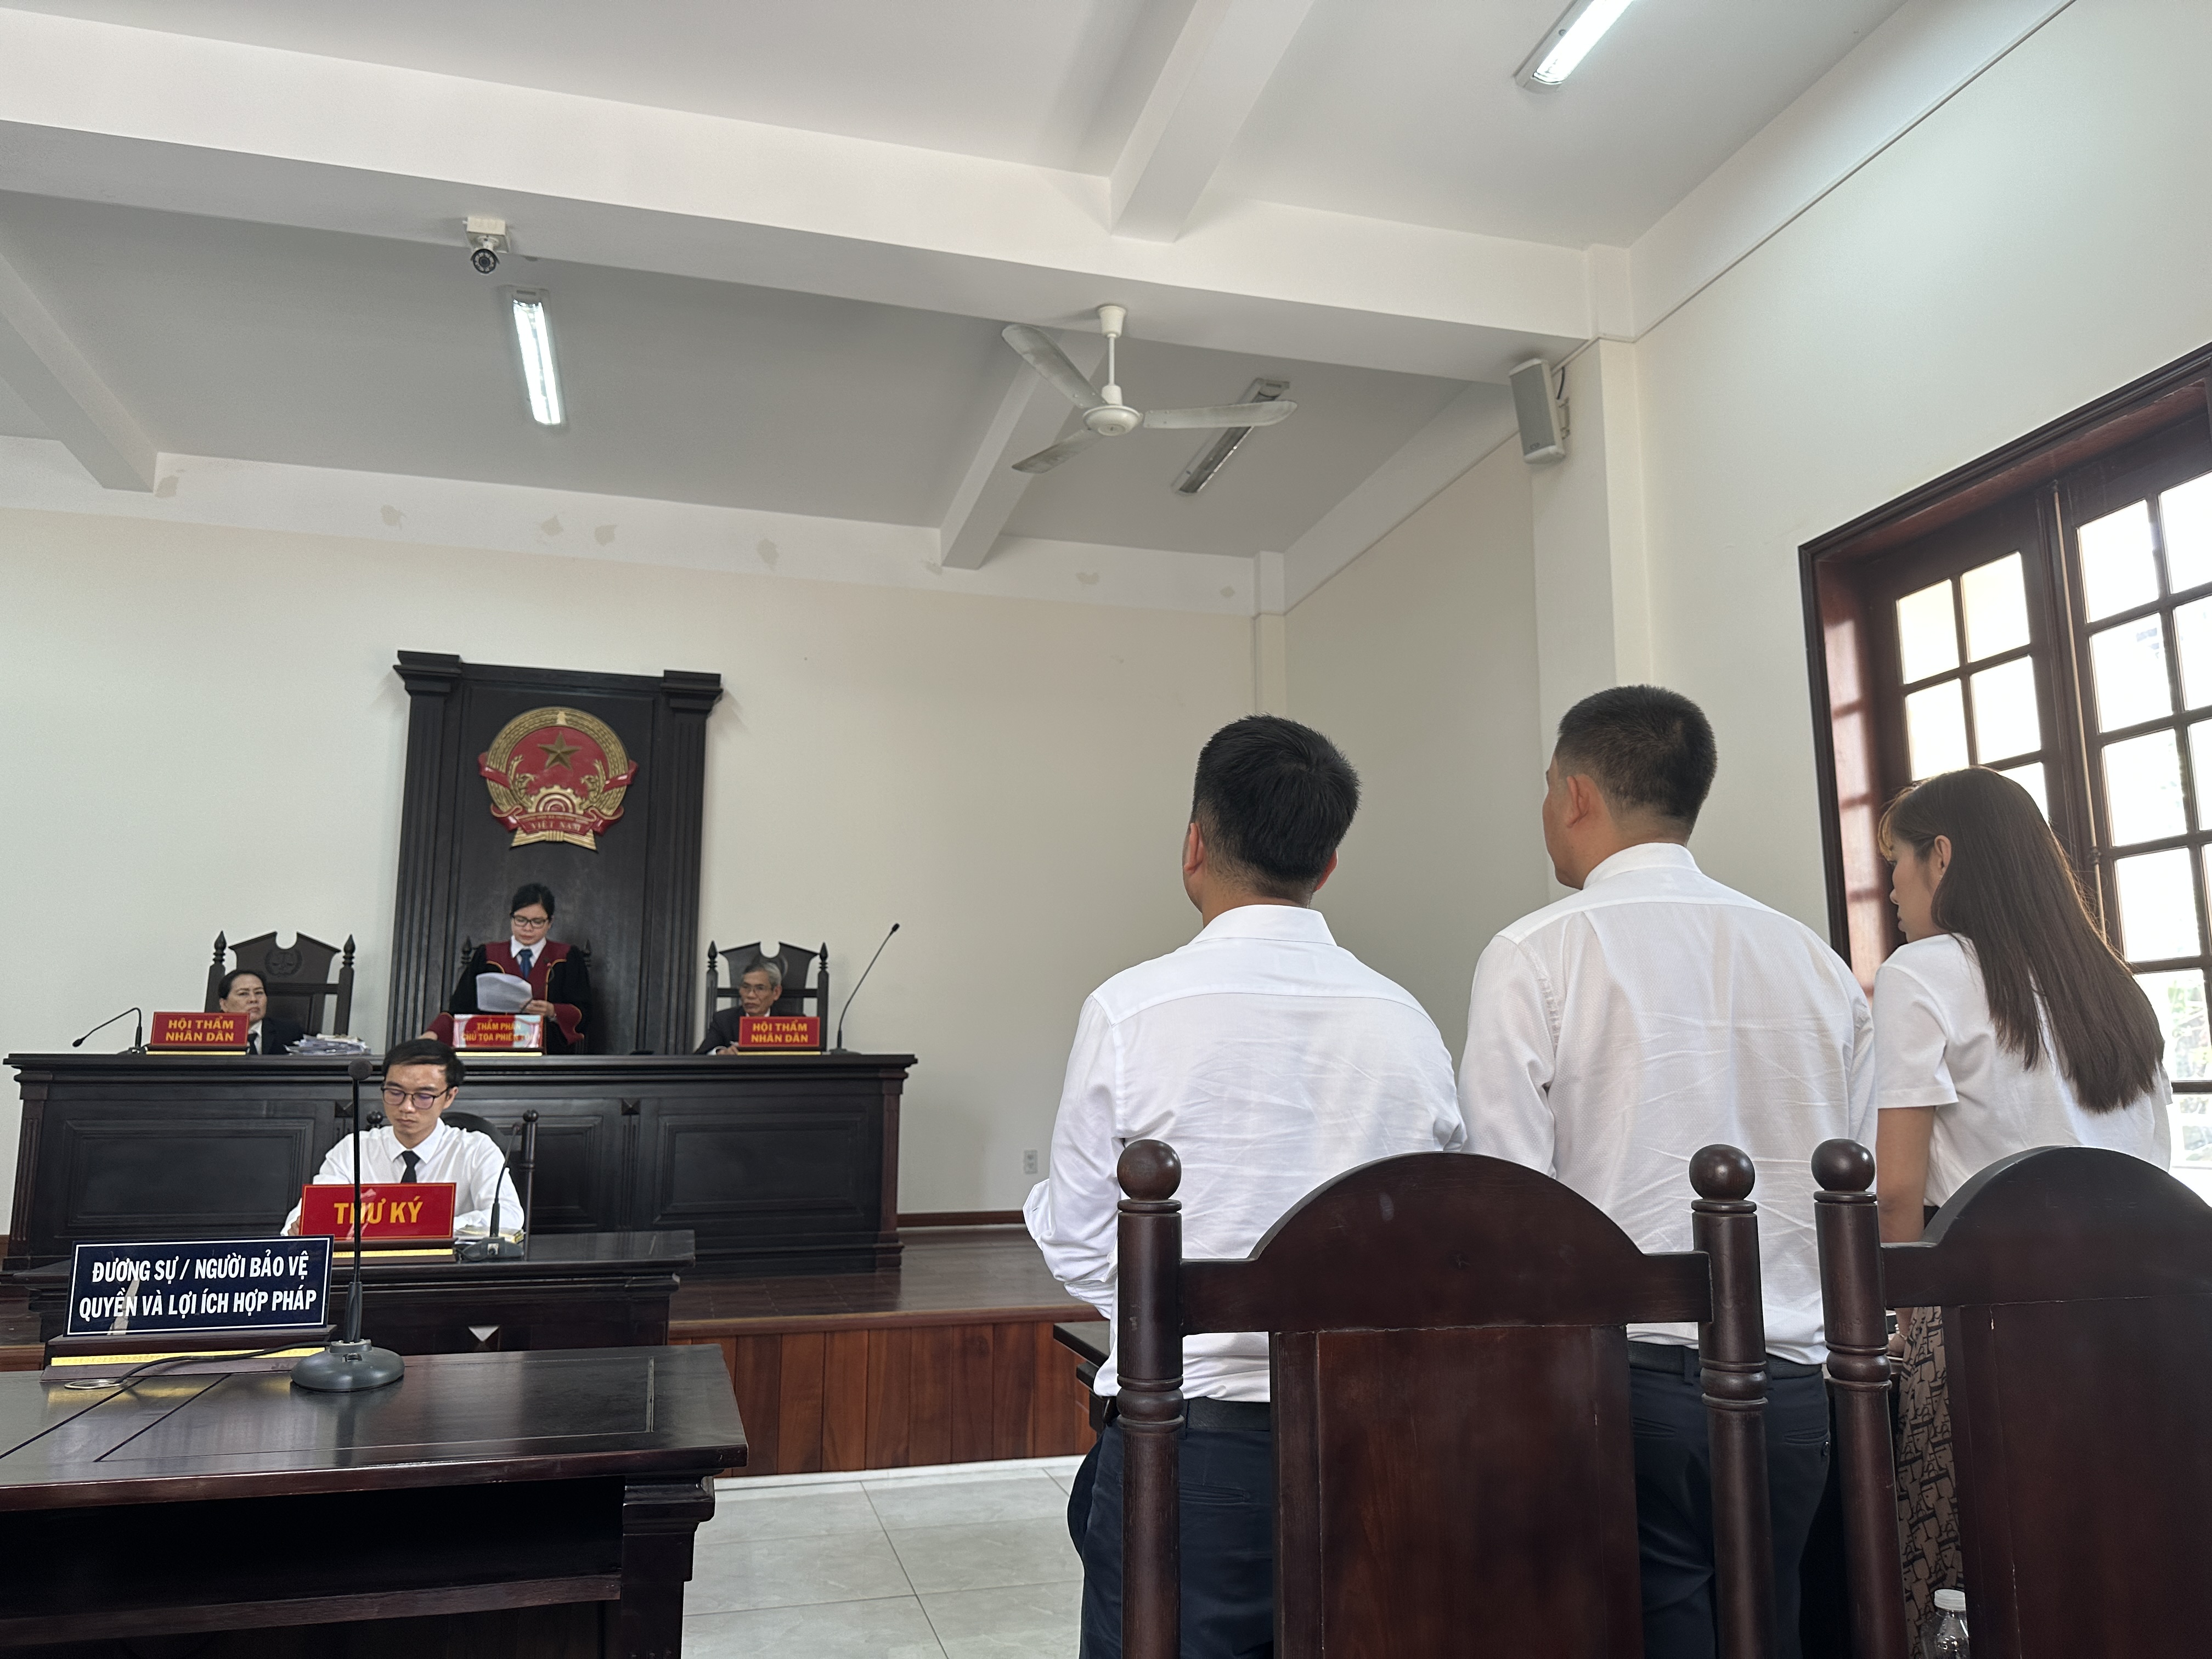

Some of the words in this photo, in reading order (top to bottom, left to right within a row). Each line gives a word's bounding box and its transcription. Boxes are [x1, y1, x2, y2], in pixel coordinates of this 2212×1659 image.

[168, 1017, 192, 1030] HỘI
[195, 1016, 234, 1029] THẨM
[752, 1020, 772, 1032] HỘI
[775, 1019, 808, 1031] THẨM
[166, 1030, 202, 1041] NHÂN
[206, 1030, 234, 1041] DÂN
[751, 1032, 782, 1042] NHÂN
[785, 1032, 808, 1042] DÂN
[390, 1195, 424, 1223] KÝ
[92, 1257, 151, 1283] ĐƯƠNG
[154, 1256, 179, 1284] SỰ
[179, 1259, 190, 1280] /
[195, 1252, 246, 1279] NGƯỜI
[250, 1249, 284, 1278] BẢO
[289, 1250, 309, 1280] VỆ
[80, 1288, 138, 1322] QUYỀN
[142, 1290, 162, 1316] VÀ
[168, 1291, 197, 1319] LỢI
[201, 1288, 229, 1314] ÍCH
[233, 1289, 268, 1316] HỢP
[272, 1285, 317, 1311] PHÁP
